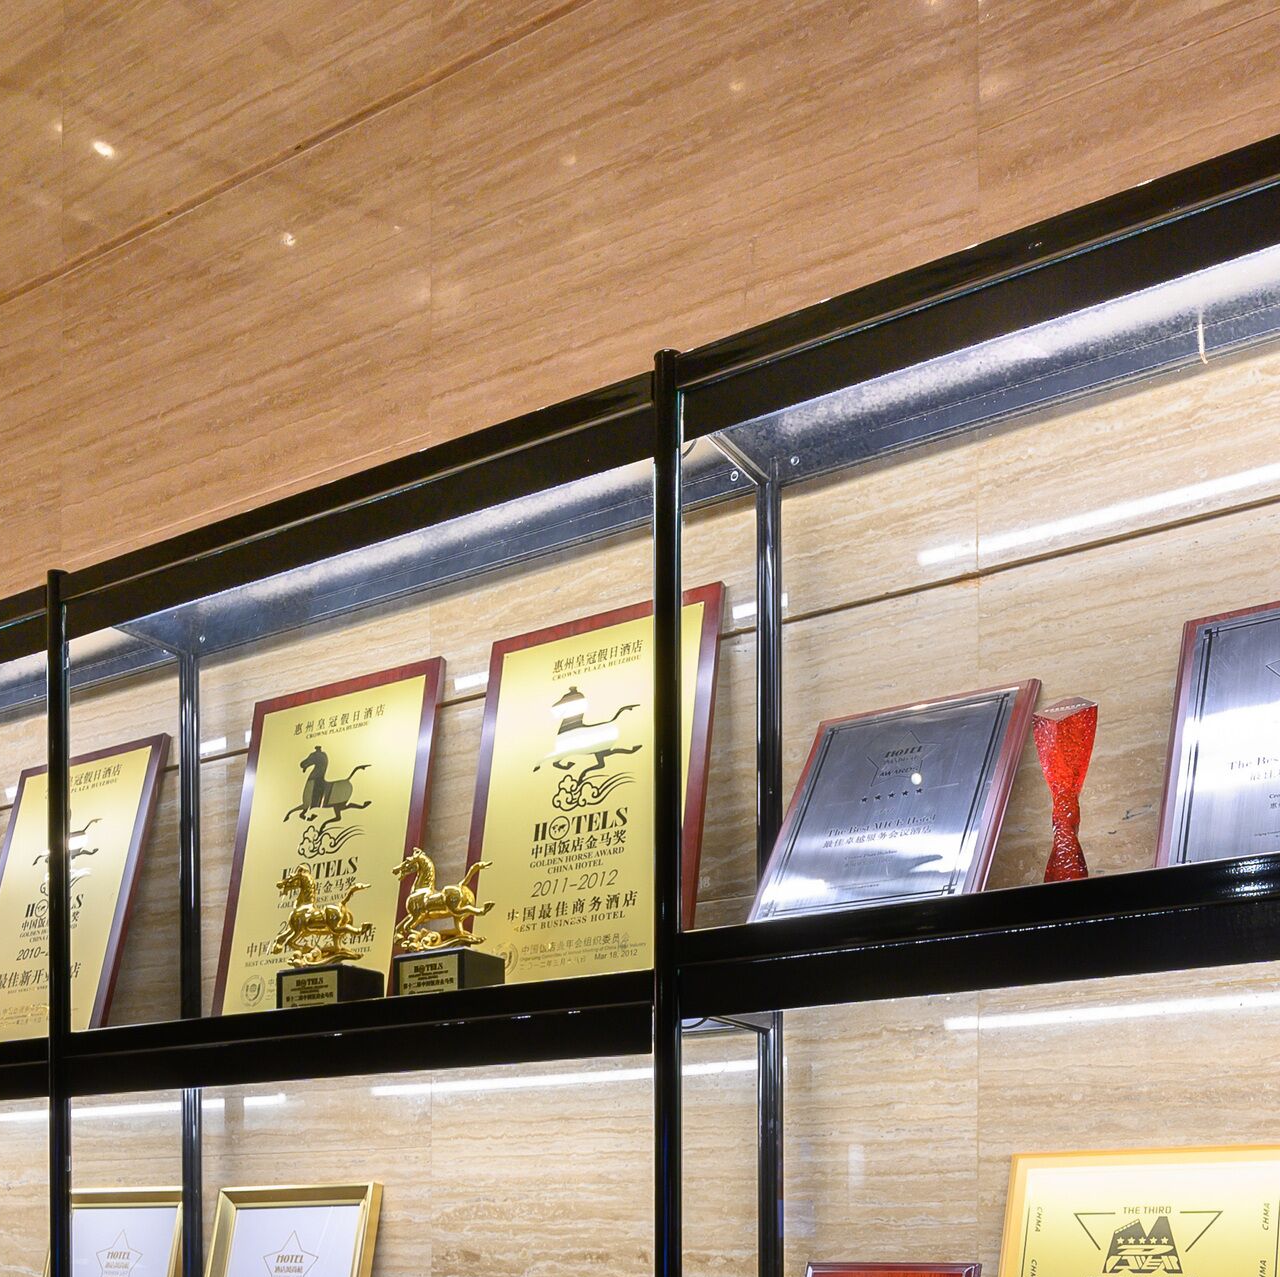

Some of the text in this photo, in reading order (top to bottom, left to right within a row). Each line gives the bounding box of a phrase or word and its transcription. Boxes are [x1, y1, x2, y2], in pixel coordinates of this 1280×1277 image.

[552, 639, 643, 674] 惠州皇冠假日酒店
[584, 663, 606, 673] PLAZA
[294, 704, 385, 736] 惠州皇冠假日酒店
[533, 807, 628, 842] HOTELS
[531, 829, 627, 859] 中国饭店金马奖
[529, 846, 625, 869] GOLDEN HORSE AWARD
[547, 859, 604, 875] CHINA HOTEL
[531, 868, 619, 898] 2011-2012
[507, 890, 638, 923] 中国最佳商务酒店
[590, 910, 626, 922] HOTEL
[621, 949, 638, 957] 2012
[1035, 1206, 1043, 1233] CHMA
[1123, 1206, 1172, 1214] THE THIRD
[1262, 1202, 1271, 1231] CHMA
[106, 1251, 131, 1260] HOTEL
[276, 1255, 304, 1264] HOTEL
